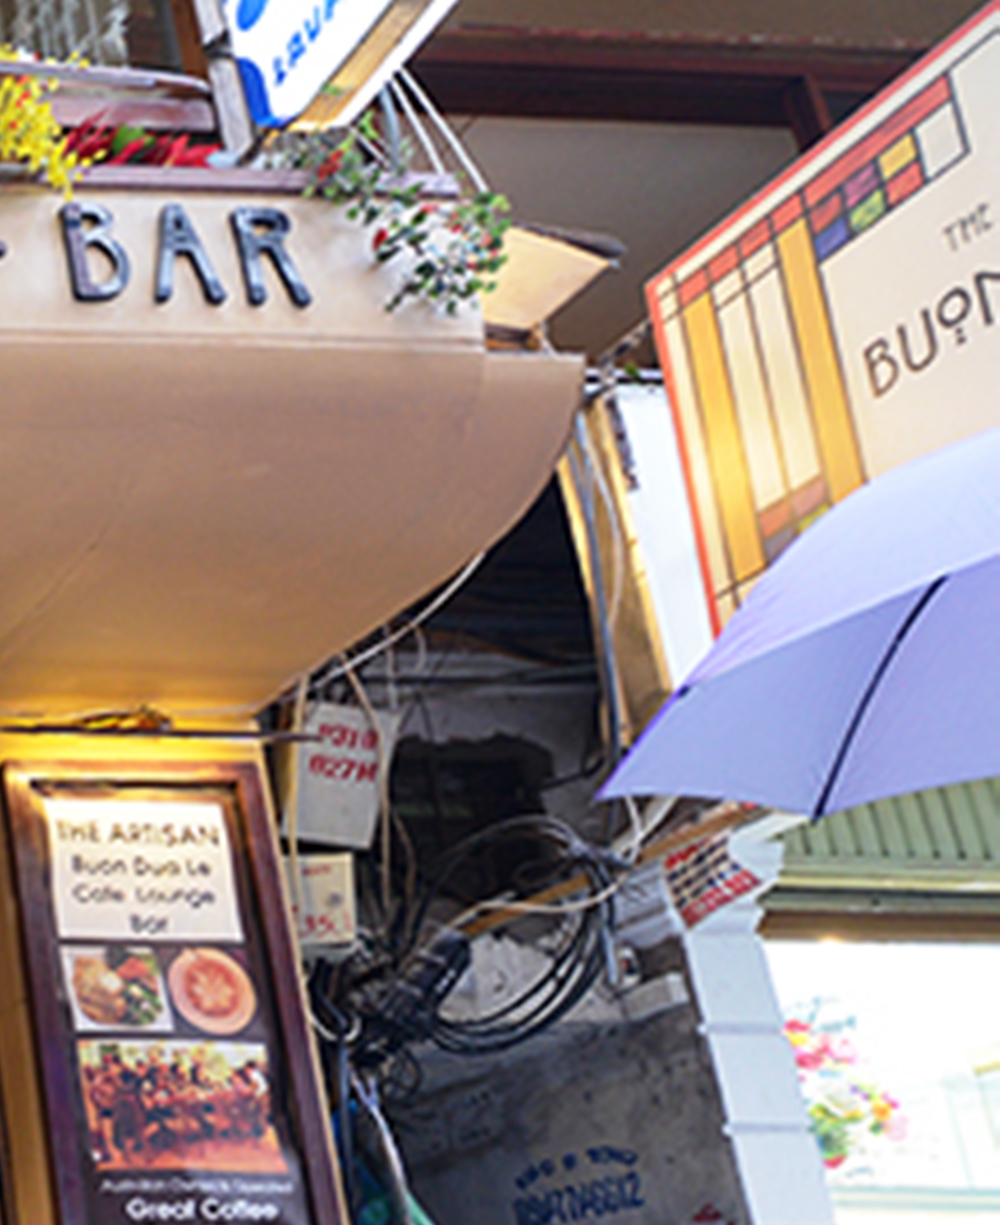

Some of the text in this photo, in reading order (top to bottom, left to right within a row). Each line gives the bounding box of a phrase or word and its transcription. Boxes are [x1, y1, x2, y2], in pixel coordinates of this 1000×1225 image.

[58, 202, 313, 307] BAR
[56, 819, 220, 847] THE ARTISAN
[125, 1196, 281, 1222] Great Coffee
